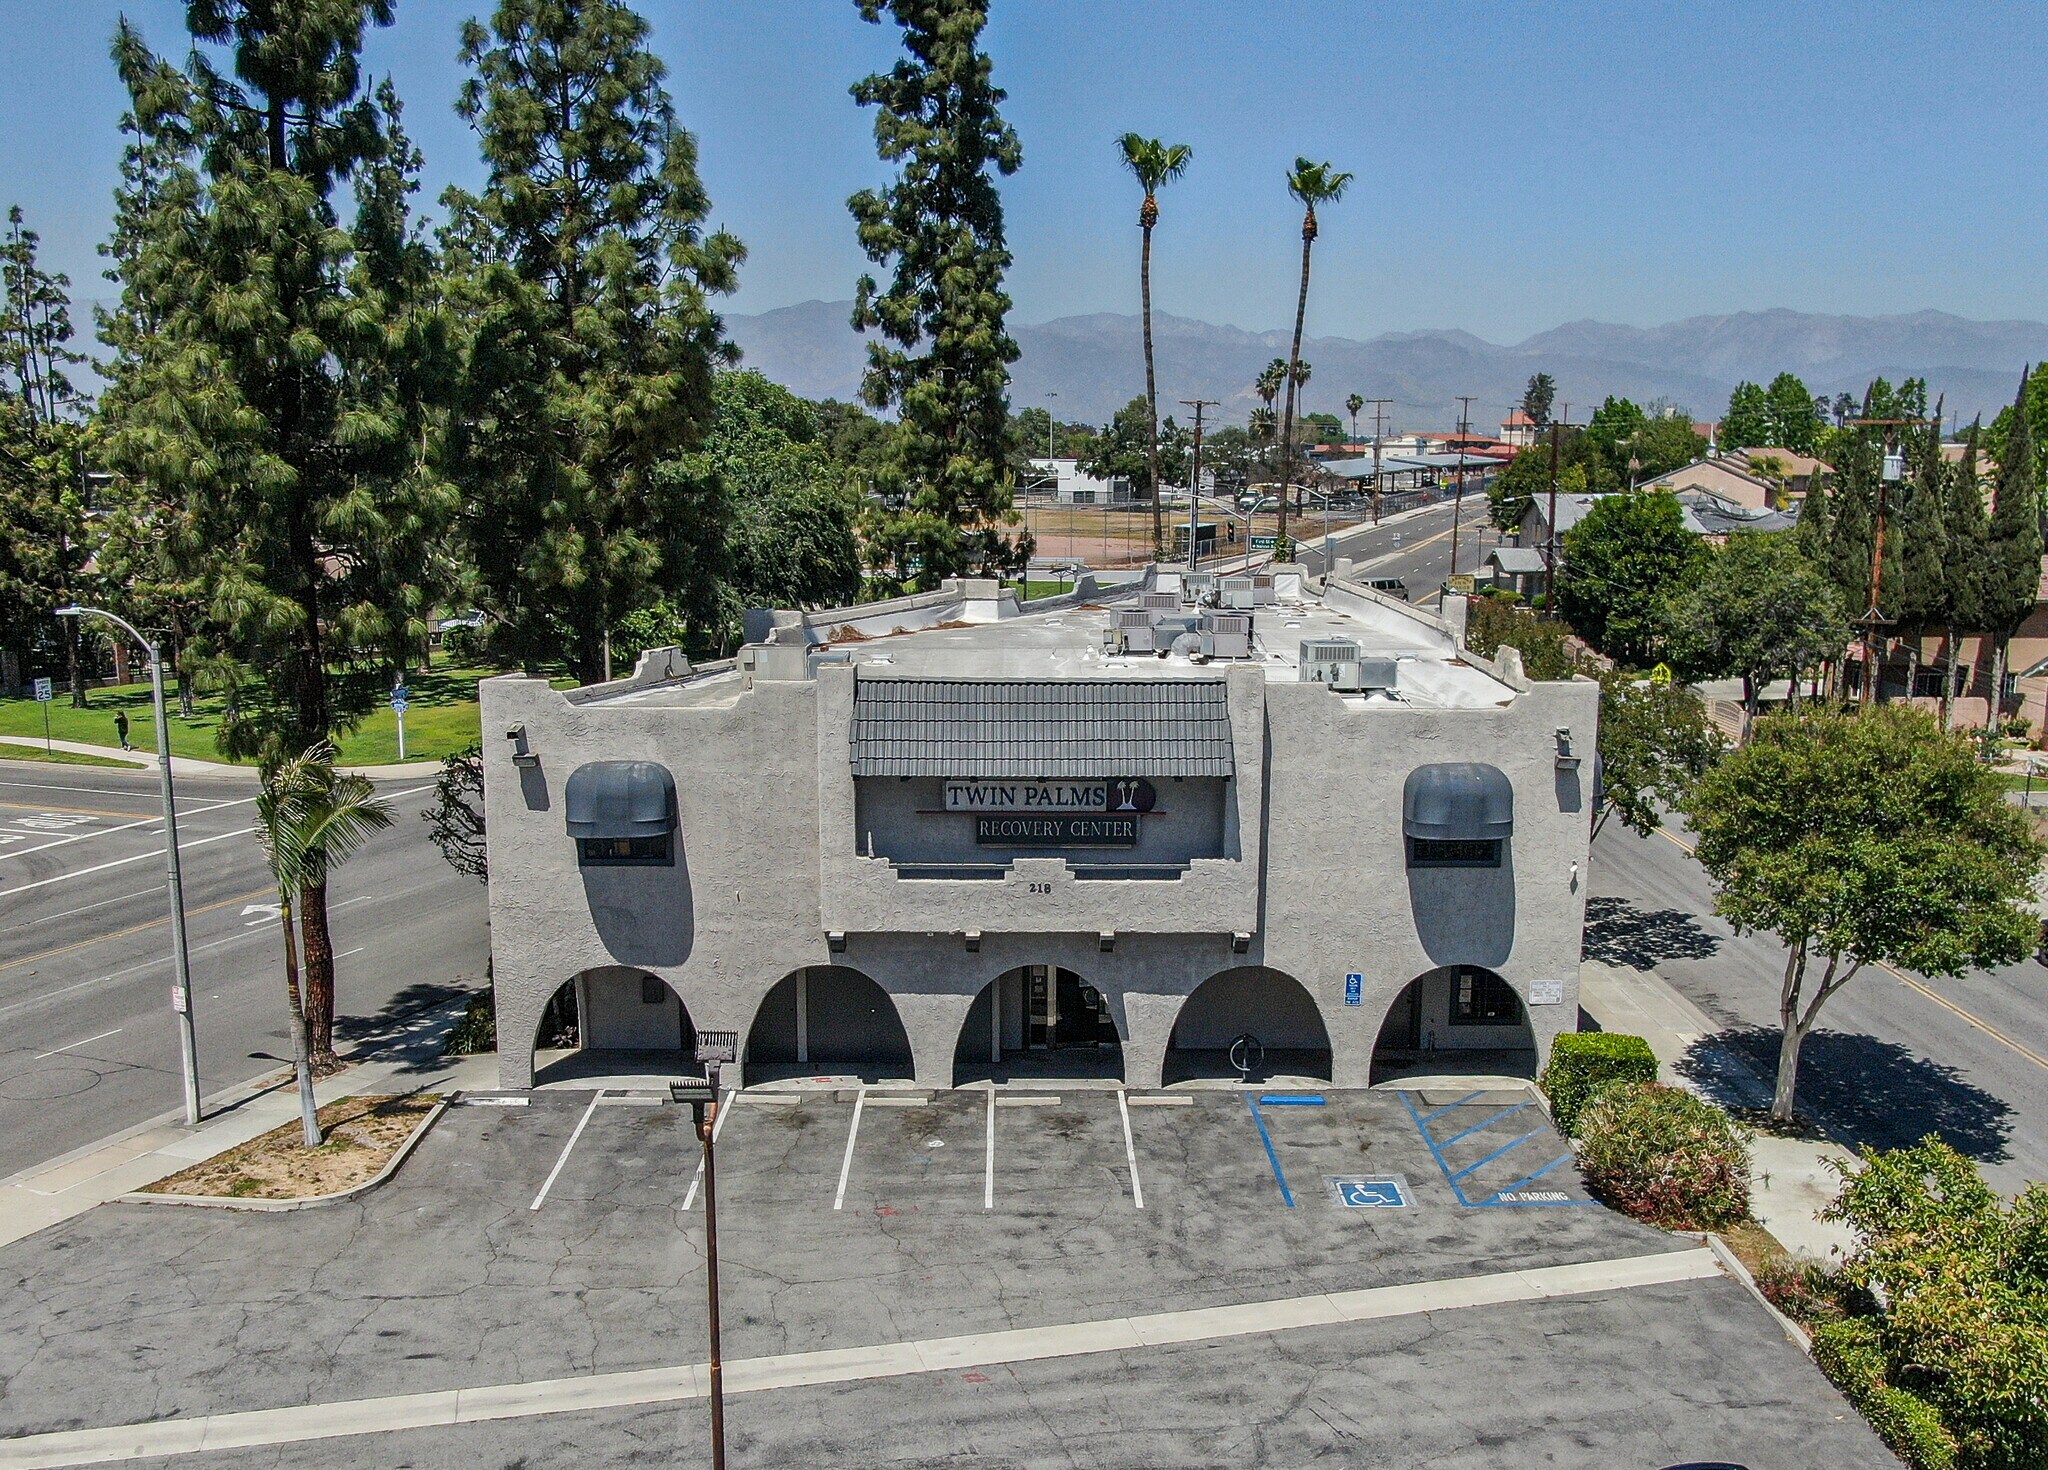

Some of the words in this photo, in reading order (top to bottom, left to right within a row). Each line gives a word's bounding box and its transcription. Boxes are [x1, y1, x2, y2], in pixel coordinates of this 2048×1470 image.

[38, 690, 50, 699] 25
[947, 786, 1015, 806] TWIN
[1024, 786, 1106, 807] PALMS
[979, 820, 1064, 837] RECOVERY
[1070, 820, 1134, 838] CENTER
[1029, 883, 1052, 895] 218
[1498, 1192, 1516, 1201] NO
[1519, 1192, 1568, 1201] PARKING
